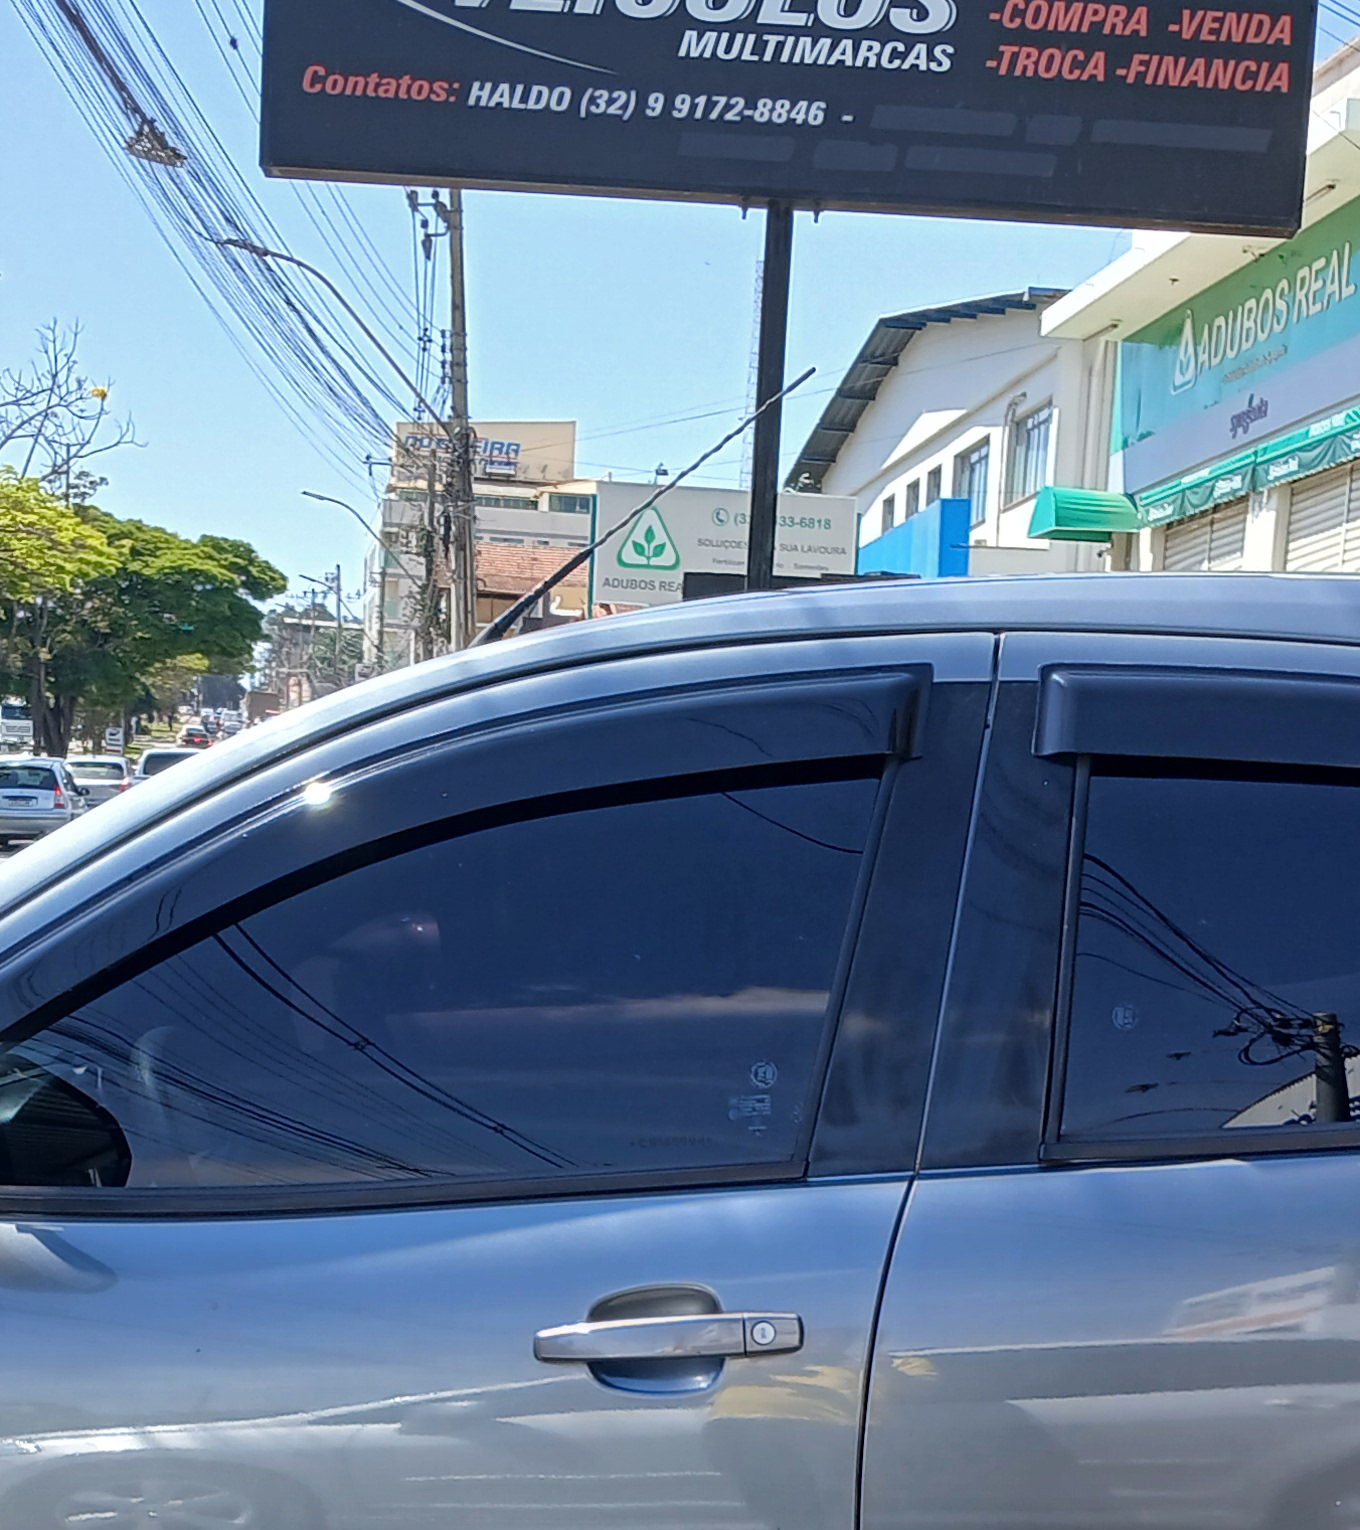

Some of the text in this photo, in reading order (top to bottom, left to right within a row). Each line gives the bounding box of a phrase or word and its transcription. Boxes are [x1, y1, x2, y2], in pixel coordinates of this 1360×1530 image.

[989, 0, 1148, 37] -COMPRA
[1168, 9, 1293, 46] -VENDA
[677, 29, 955, 73] MULTIMARCAS
[985, 44, 1290, 93] -TROCA -FINANCIA
[302, 65, 460, 103] Contatos:
[467, 81, 570, 112] HALDO
[580, 88, 637, 121] (32)
[645, 92, 665, 118] 9
[671, 93, 828, 126] 9172-8846
[1195, 278, 1291, 376] ADUBOS
[1293, 241, 1358, 324] REAL
[801, 544, 847, 556] LAVOURA
[601, 577, 682, 593] ADUBOS REA
